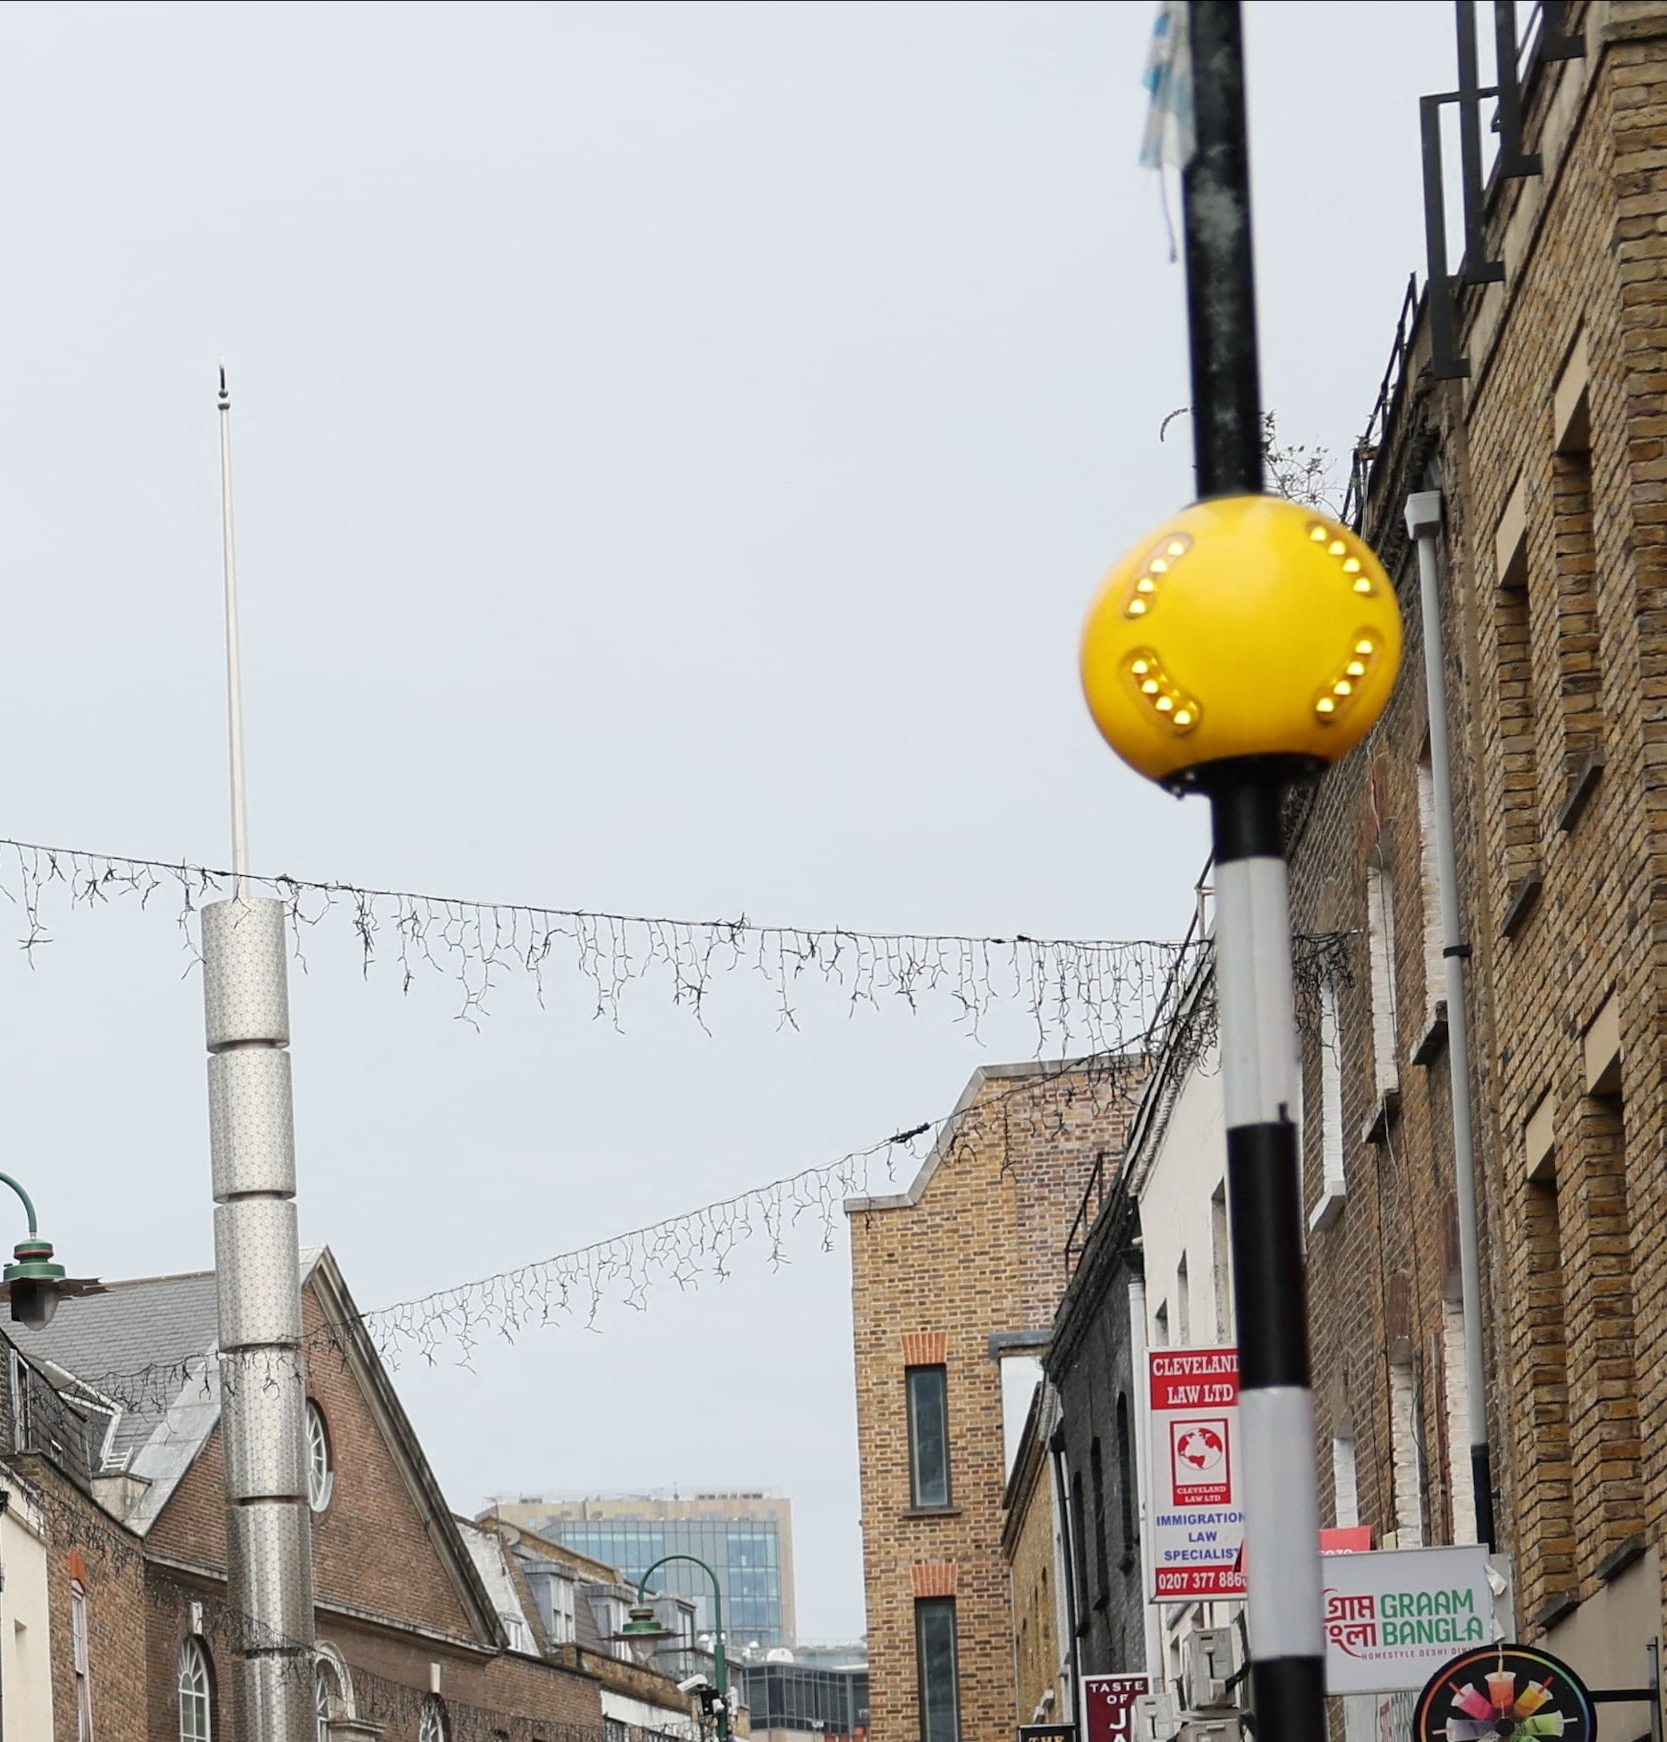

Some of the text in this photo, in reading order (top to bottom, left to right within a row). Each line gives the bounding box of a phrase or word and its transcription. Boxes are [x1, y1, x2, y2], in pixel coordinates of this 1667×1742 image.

[1167, 1383, 1234, 1405] LAW LTD
[1177, 1485, 1227, 1496] CLEVELAND
[1185, 1494, 1222, 1504] LAW LTD
[1156, 1512, 1246, 1527] IMMIGRATION
[1188, 1531, 1217, 1543] LAW
[1158, 1573, 1188, 1590] 0207
[1192, 1573, 1215, 1589] 377
[1380, 1589, 1474, 1619] GRAAM
[1382, 1616, 1484, 1646] BANGLA
[1089, 1680, 1145, 1693] TASTE
[1106, 1694, 1128, 1705] OF
